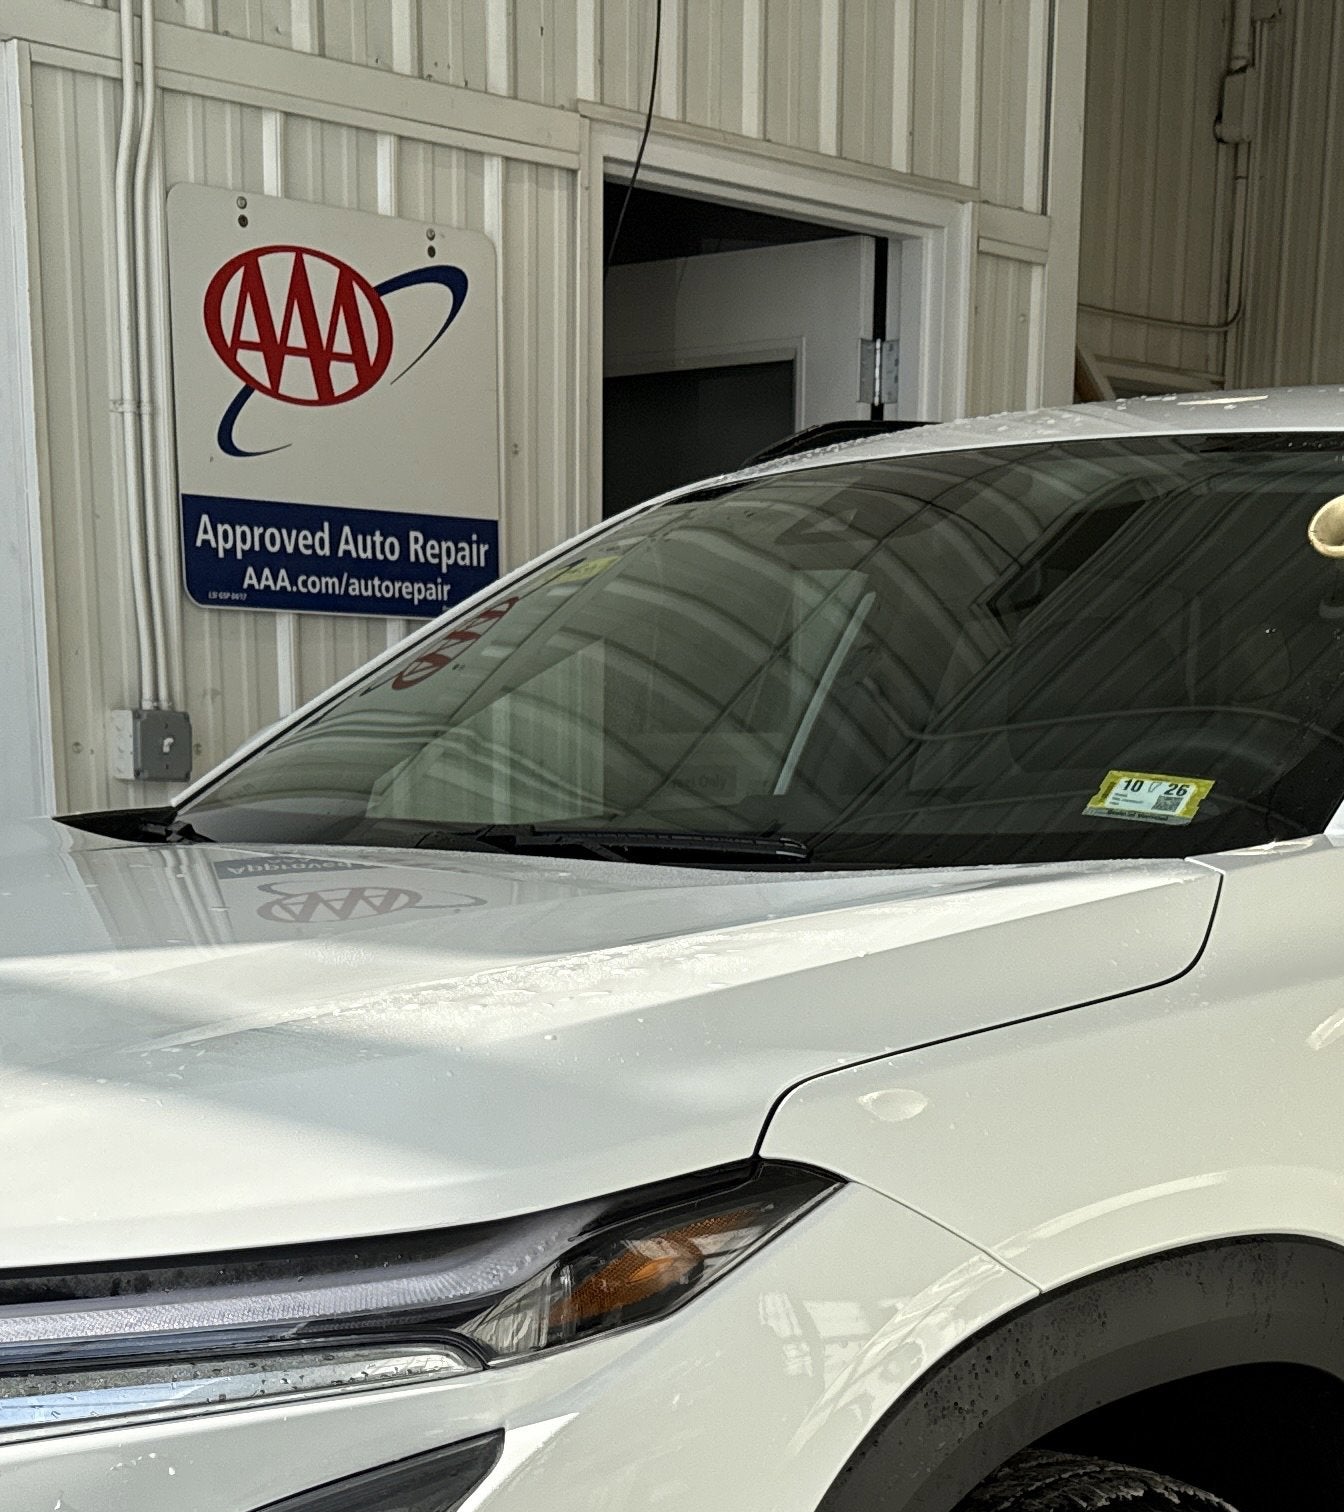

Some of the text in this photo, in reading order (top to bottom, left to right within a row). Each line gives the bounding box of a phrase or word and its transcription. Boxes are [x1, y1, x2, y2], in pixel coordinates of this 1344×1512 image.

[218, 246, 383, 405] AAA
[196, 514, 490, 573] Approved Auto Repair
[243, 567, 450, 606] AAA.com/autorepair
[1123, 778, 1144, 793] 10
[1164, 783, 1189, 797] 26
